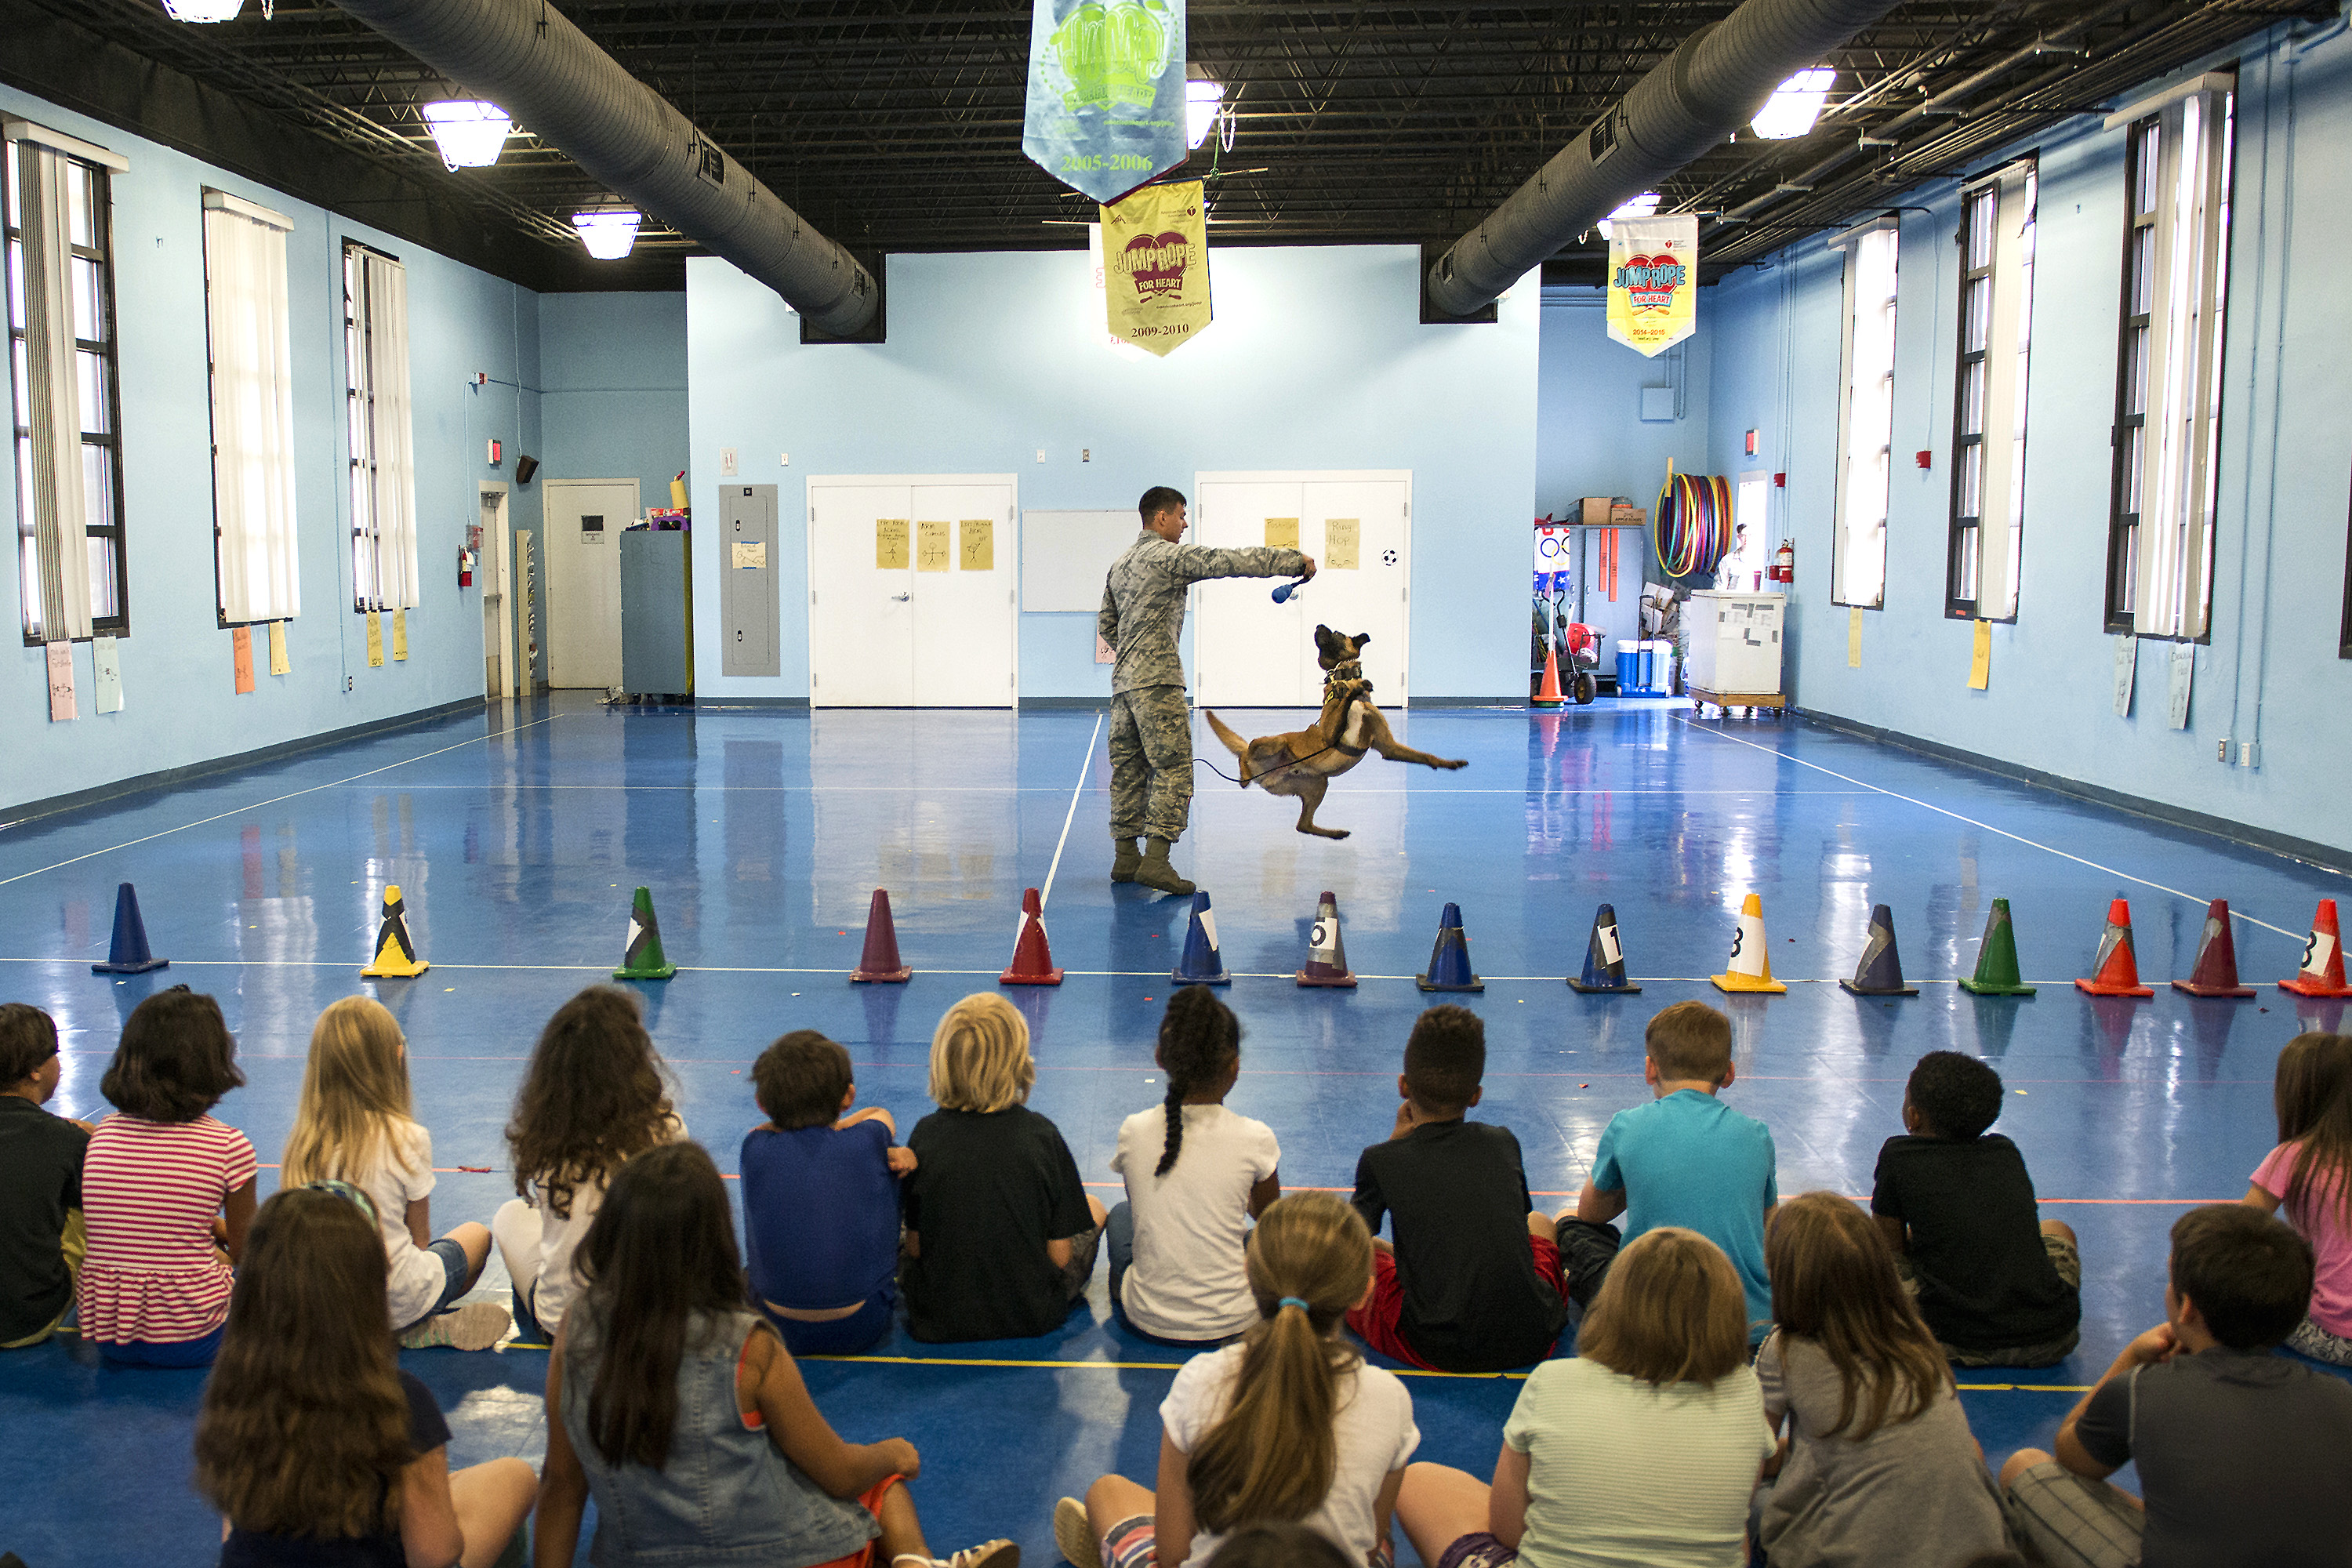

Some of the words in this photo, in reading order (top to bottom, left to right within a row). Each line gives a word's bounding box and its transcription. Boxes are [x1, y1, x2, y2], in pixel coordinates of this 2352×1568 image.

[1061, 154, 1153, 172] 2005-2006
[1113, 247, 1156, 274] JUMP
[1156, 241, 1197, 272] ROPE
[1613, 265, 1650, 289] JUMP
[1650, 263, 1686, 289] ROPE
[1138, 279, 1154, 292] FOR
[1156, 278, 1182, 289] HEART
[1648, 295, 1671, 304] HEART
[1131, 323, 1189, 338] 2009-2010
[1331, 521, 1352, 533] Ring
[1610, 926, 1622, 956] 1
